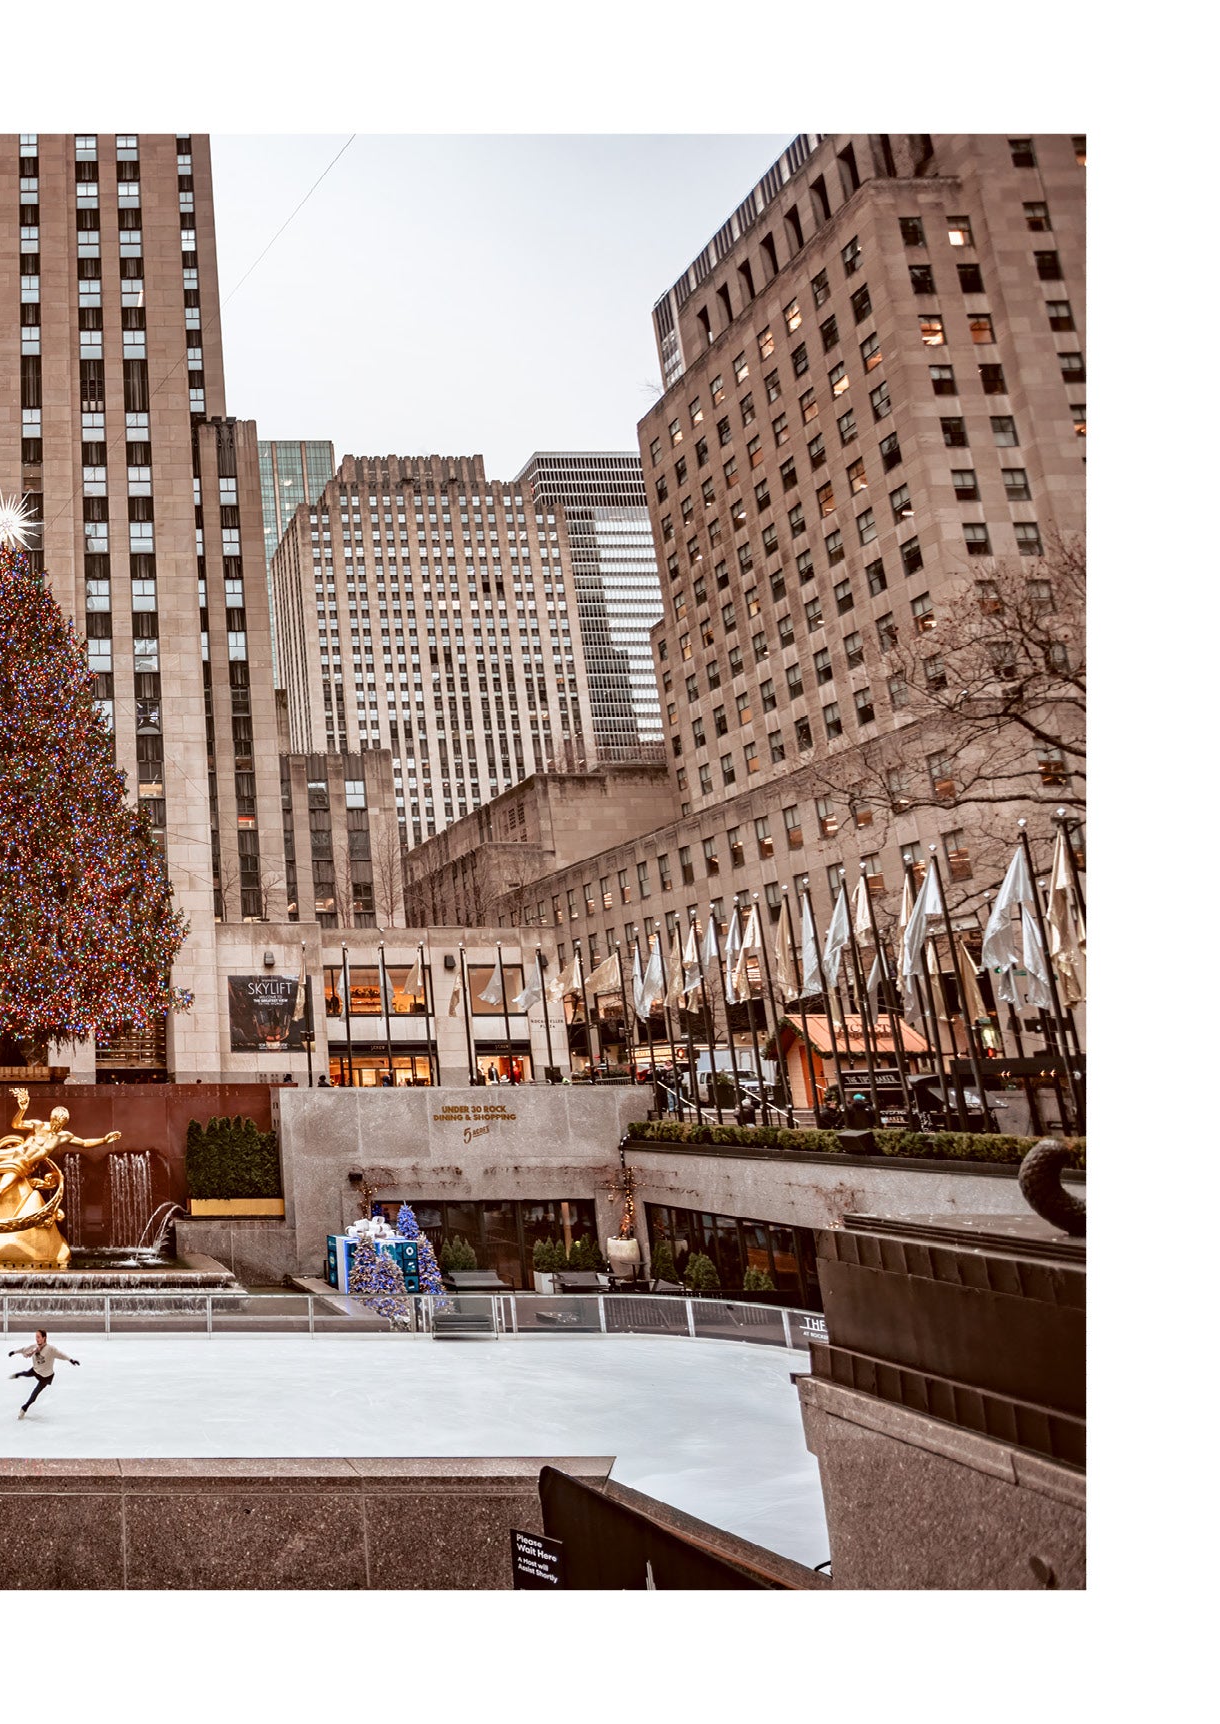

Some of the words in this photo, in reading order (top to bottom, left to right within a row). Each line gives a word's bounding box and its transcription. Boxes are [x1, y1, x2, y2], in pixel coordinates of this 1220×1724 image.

[248, 982, 292, 994] SKYLIFT
[463, 1127, 472, 1144] 5
[804, 1316, 826, 1331] THE
[516, 1533, 543, 1548] Please
[516, 1542, 536, 1556] Wait
[537, 1549, 557, 1562] Here
[523, 1558, 537, 1568] Host
[537, 1564, 549, 1572] will
[518, 1563, 535, 1574] Assist
[535, 1569, 558, 1584] Shortly
